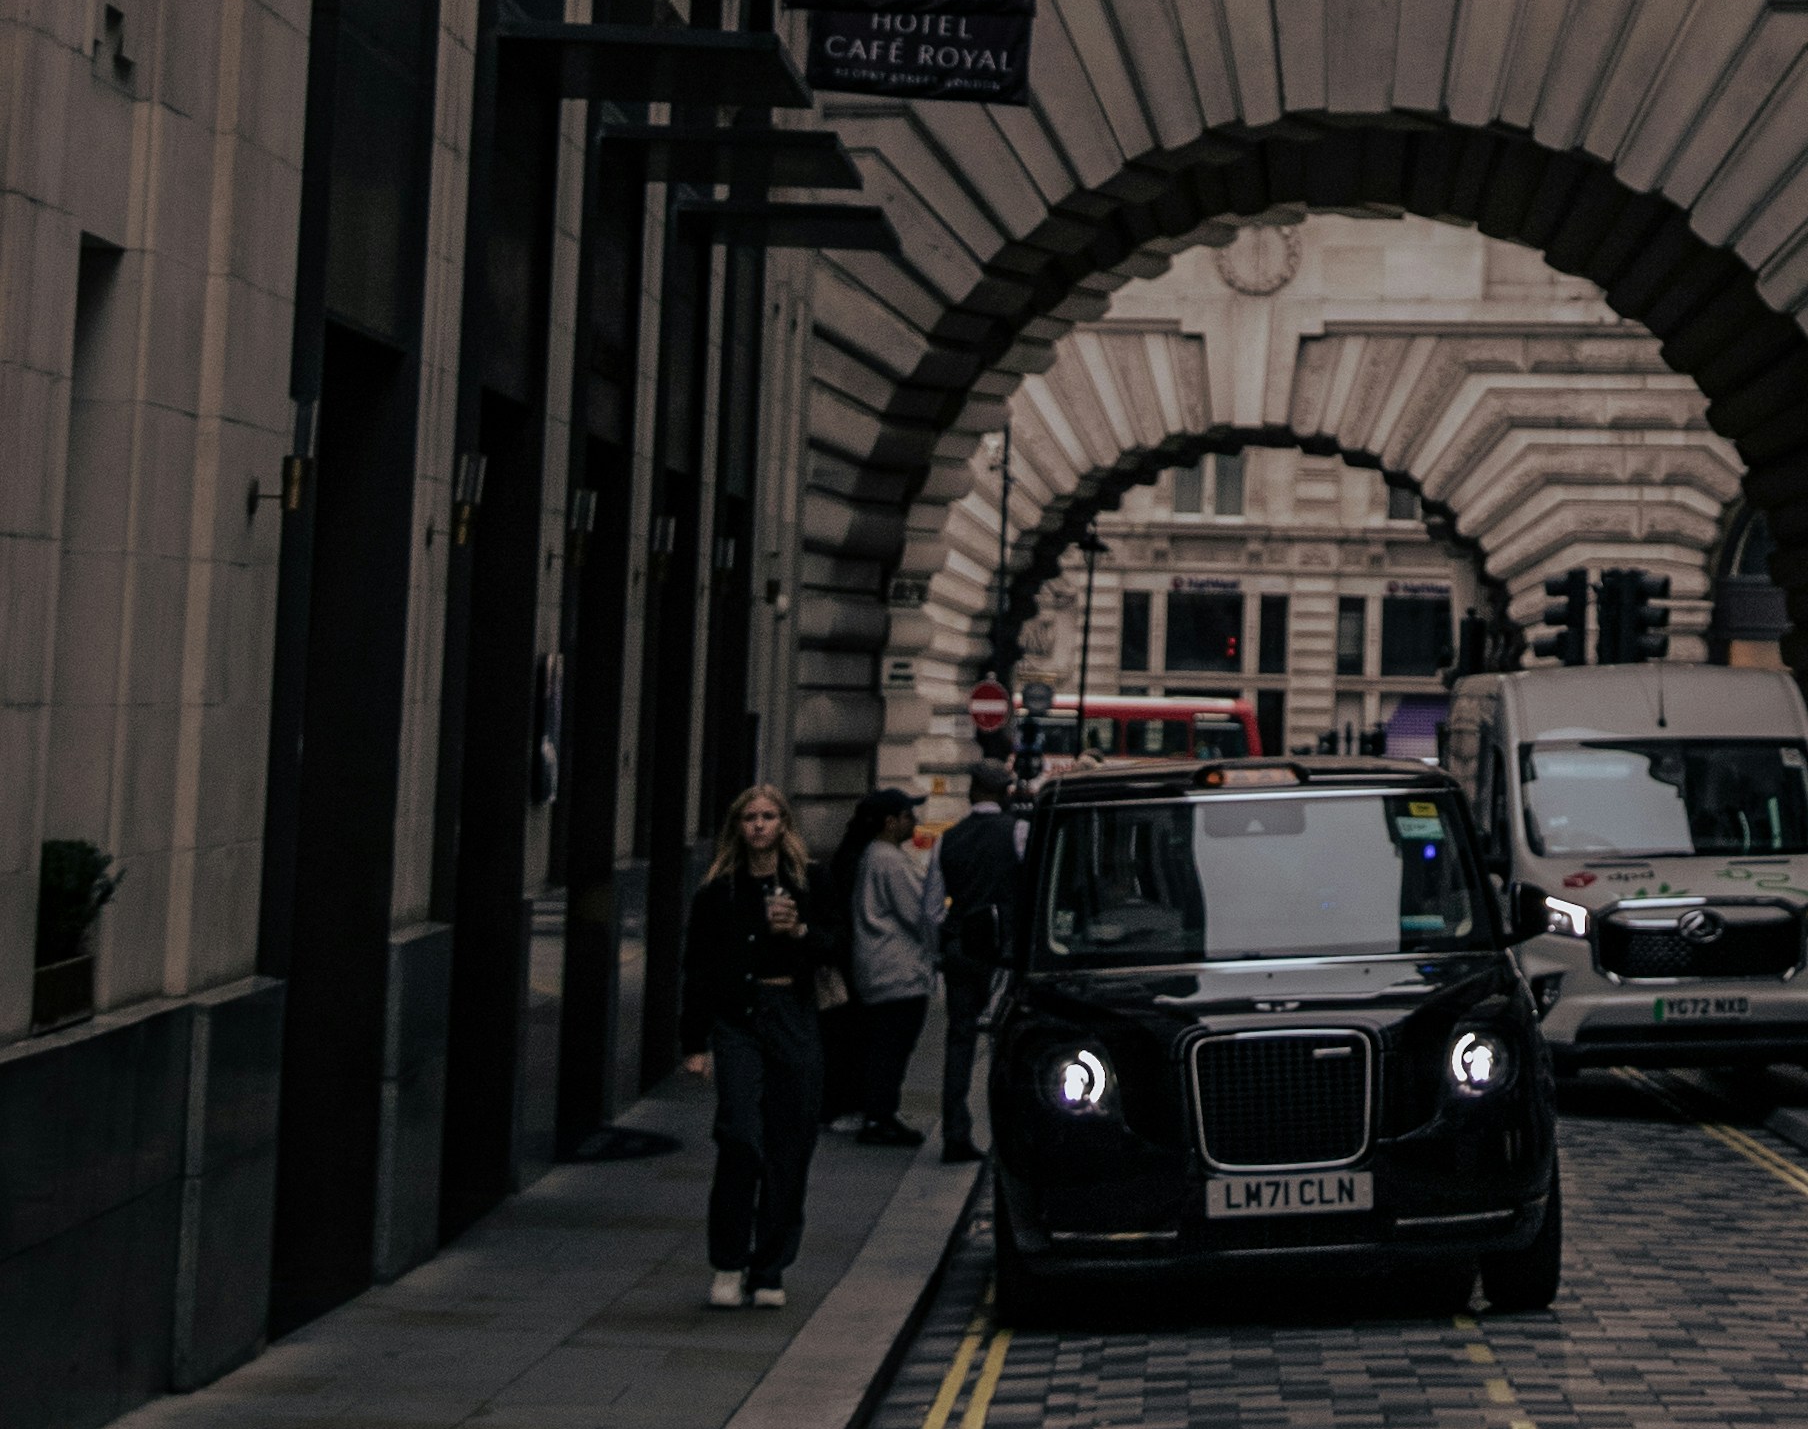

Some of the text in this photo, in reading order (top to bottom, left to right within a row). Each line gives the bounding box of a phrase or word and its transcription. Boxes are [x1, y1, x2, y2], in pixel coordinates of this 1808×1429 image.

[871, 13, 973, 40] HOTEL
[823, 35, 1013, 73] CAFÉ ROYAL
[1225, 1176, 1356, 1209] LM71 CLN
